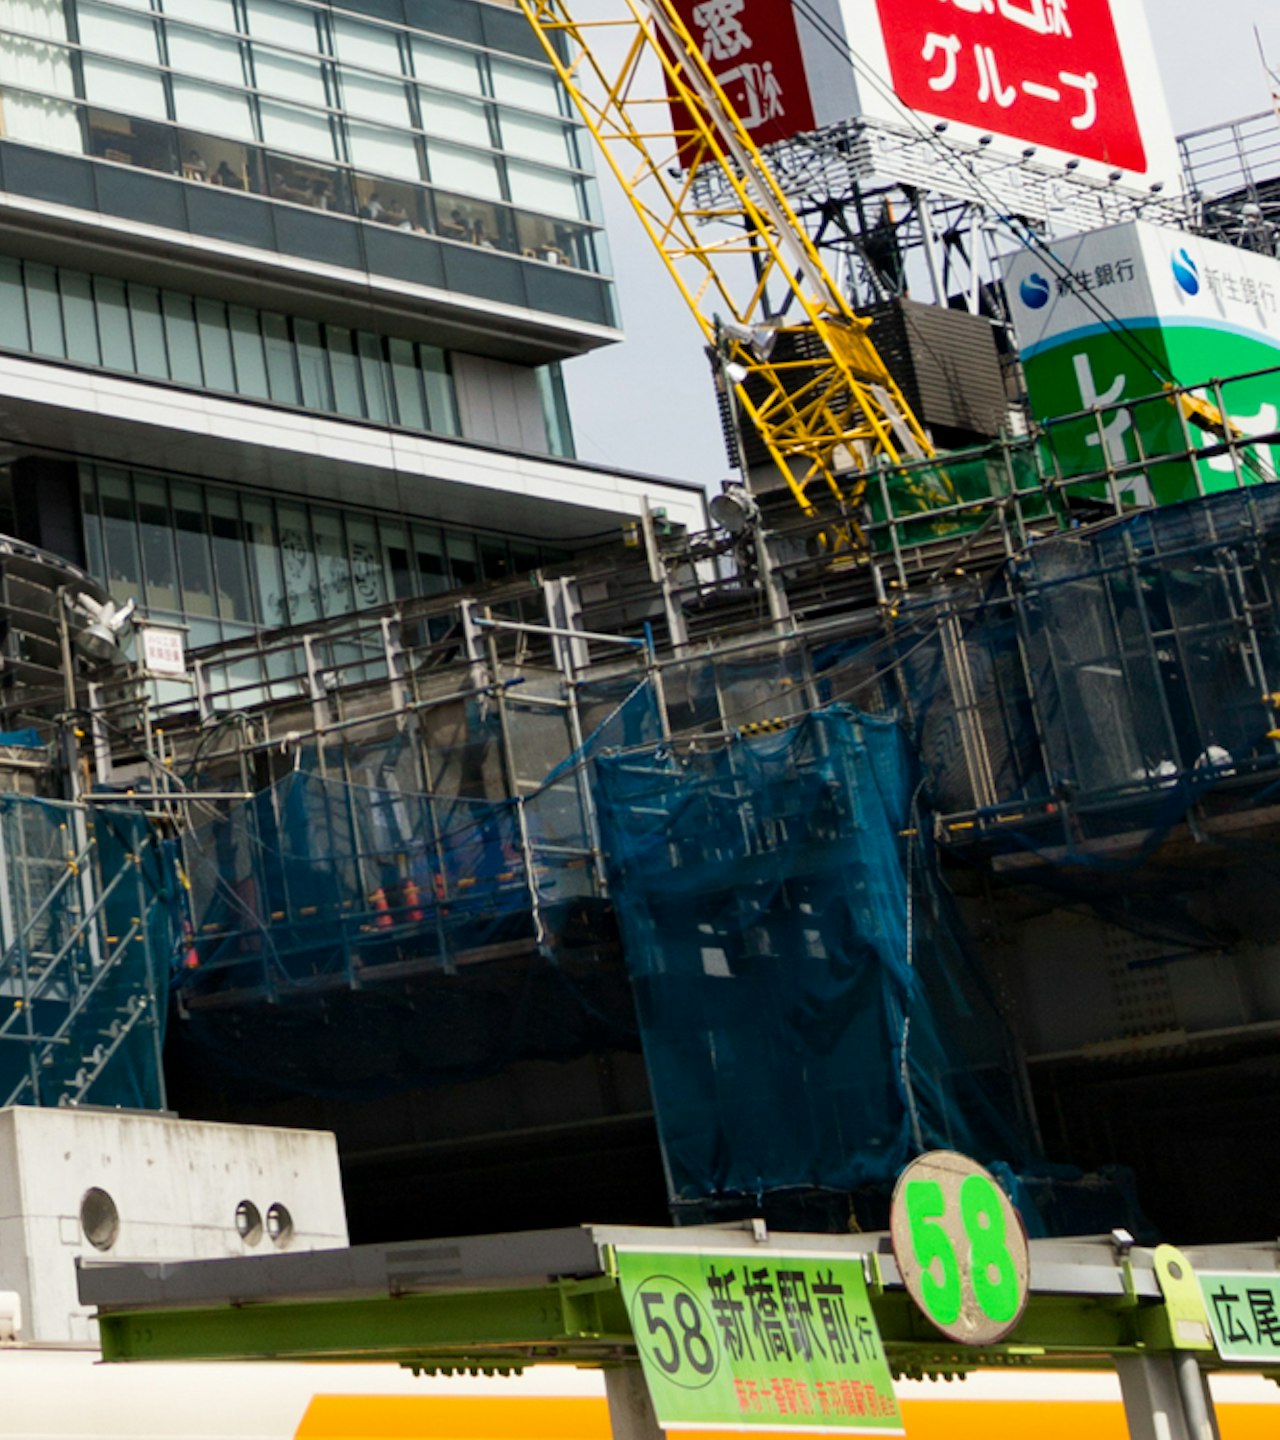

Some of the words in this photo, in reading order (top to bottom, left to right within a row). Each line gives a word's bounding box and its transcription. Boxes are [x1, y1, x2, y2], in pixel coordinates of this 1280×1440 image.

[921, 31, 1099, 131] グループ
[1055, 257, 1135, 299] 新生銀行
[906, 1176, 1018, 1325] 58
[639, 1291, 715, 1375] 58
